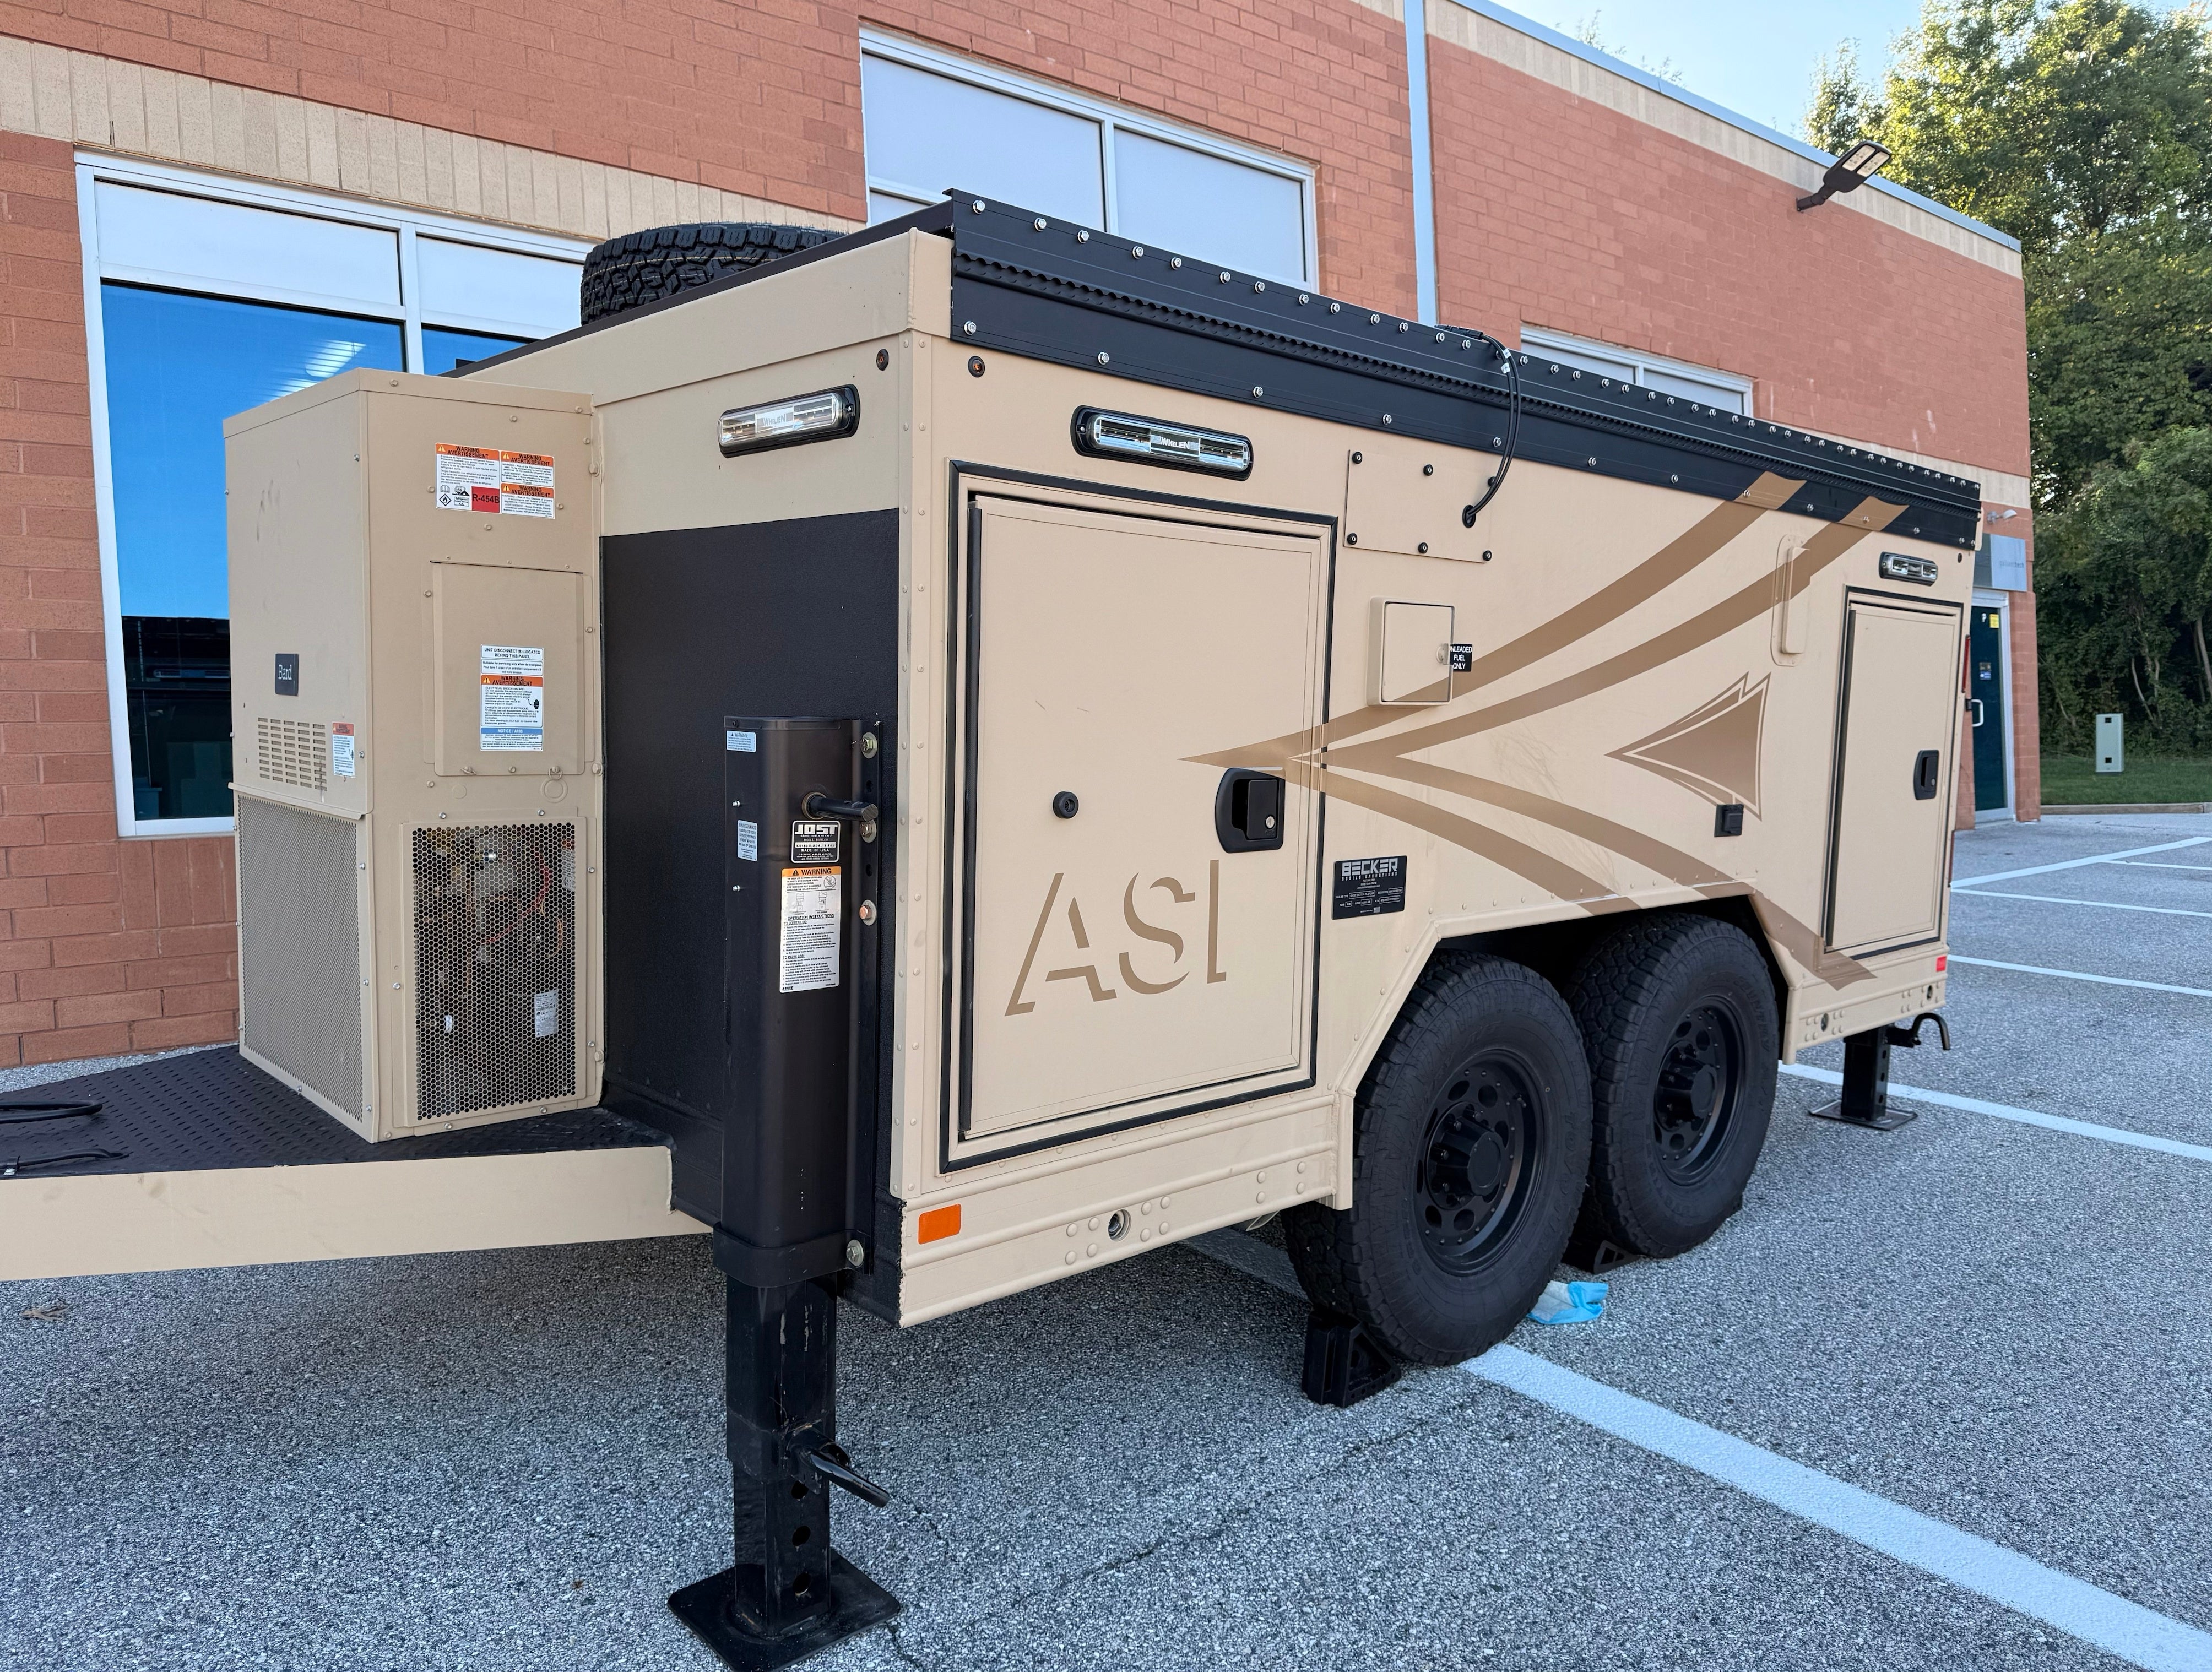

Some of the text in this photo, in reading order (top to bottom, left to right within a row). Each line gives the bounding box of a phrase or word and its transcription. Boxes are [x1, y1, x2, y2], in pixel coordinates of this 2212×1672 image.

[763, 414, 785, 426] WHELEN
[1161, 436, 1190, 449] WHELEN
[447, 450, 489, 458] AVERTISSEMENT
[511, 458, 550, 466] AVERTISSEMENT
[473, 494, 500, 503] R-454B
[278, 665, 292, 680] Bard
[795, 824, 838, 834] JOST
[1342, 858, 1398, 876] BECKER
[1005, 860, 1227, 1016] ASI
